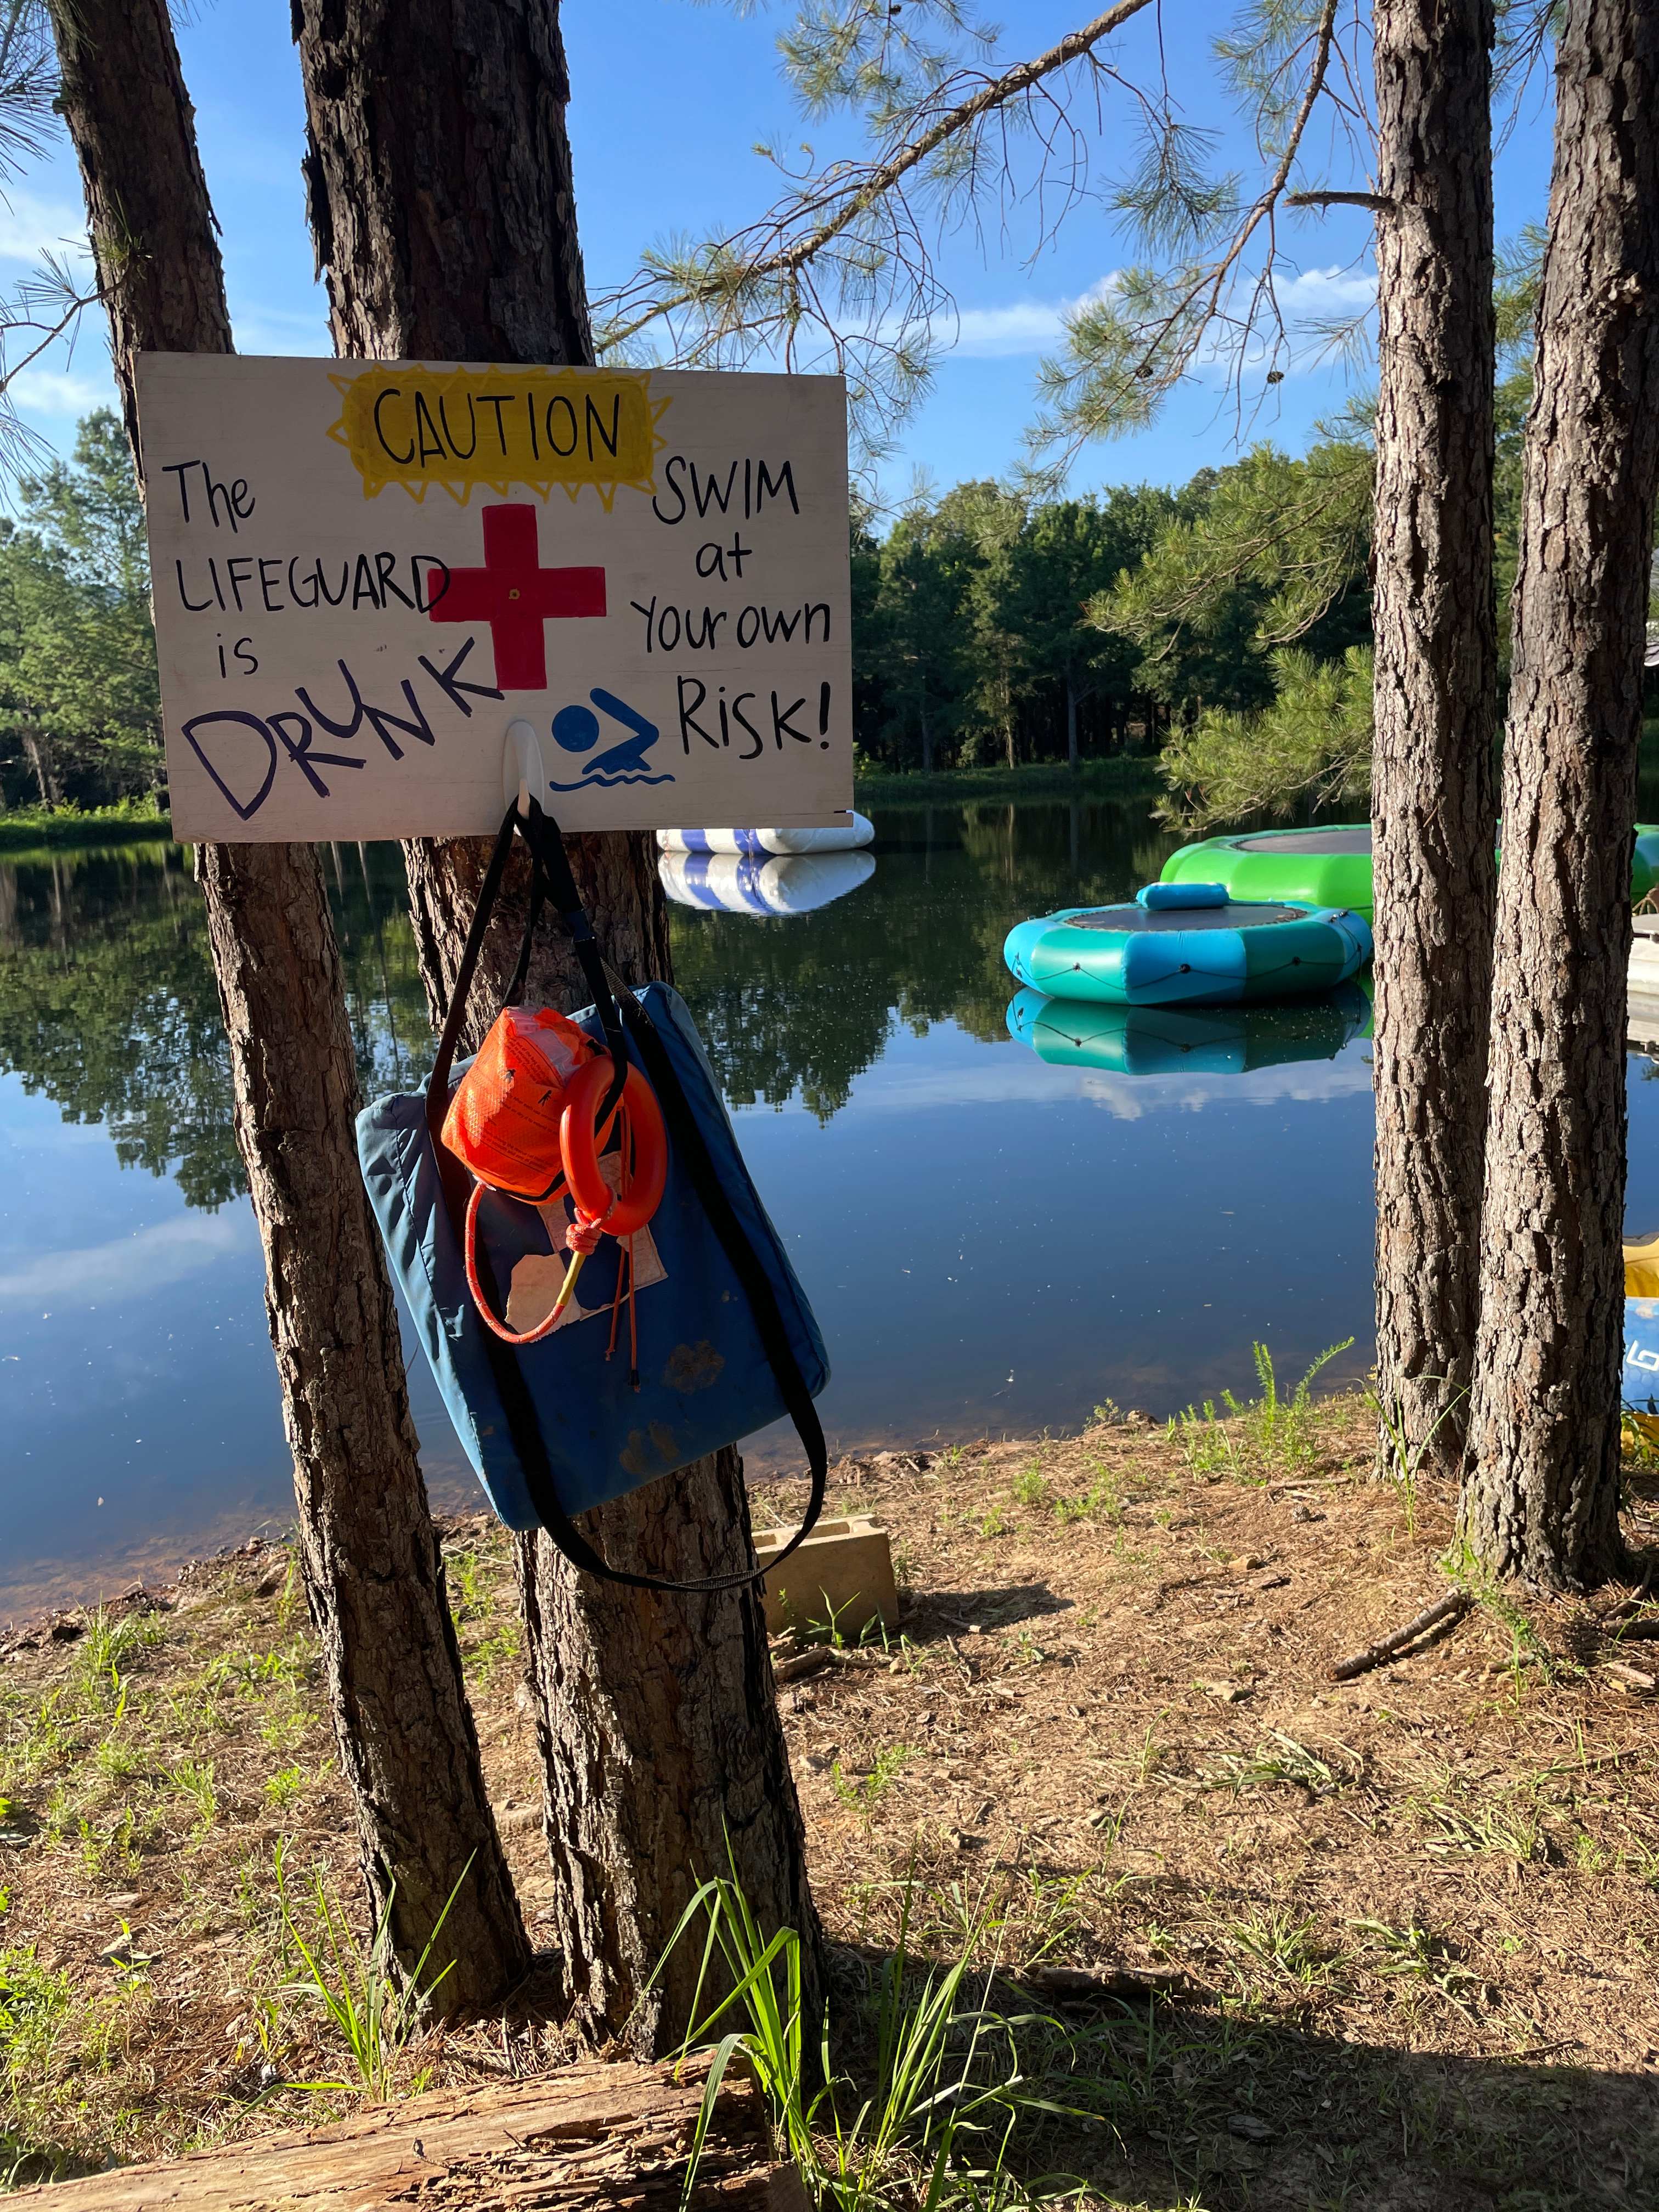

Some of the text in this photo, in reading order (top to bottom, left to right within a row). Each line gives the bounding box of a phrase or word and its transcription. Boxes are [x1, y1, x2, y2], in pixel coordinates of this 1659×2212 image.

[374, 388, 620, 469] CAUTION
[161, 459, 256, 534] The
[652, 455, 799, 525] SWIM
[175, 552, 454, 614] LIFEGUARD
[695, 531, 753, 582] at
[217, 634, 258, 679] is
[180, 636, 506, 822] DRUNK
